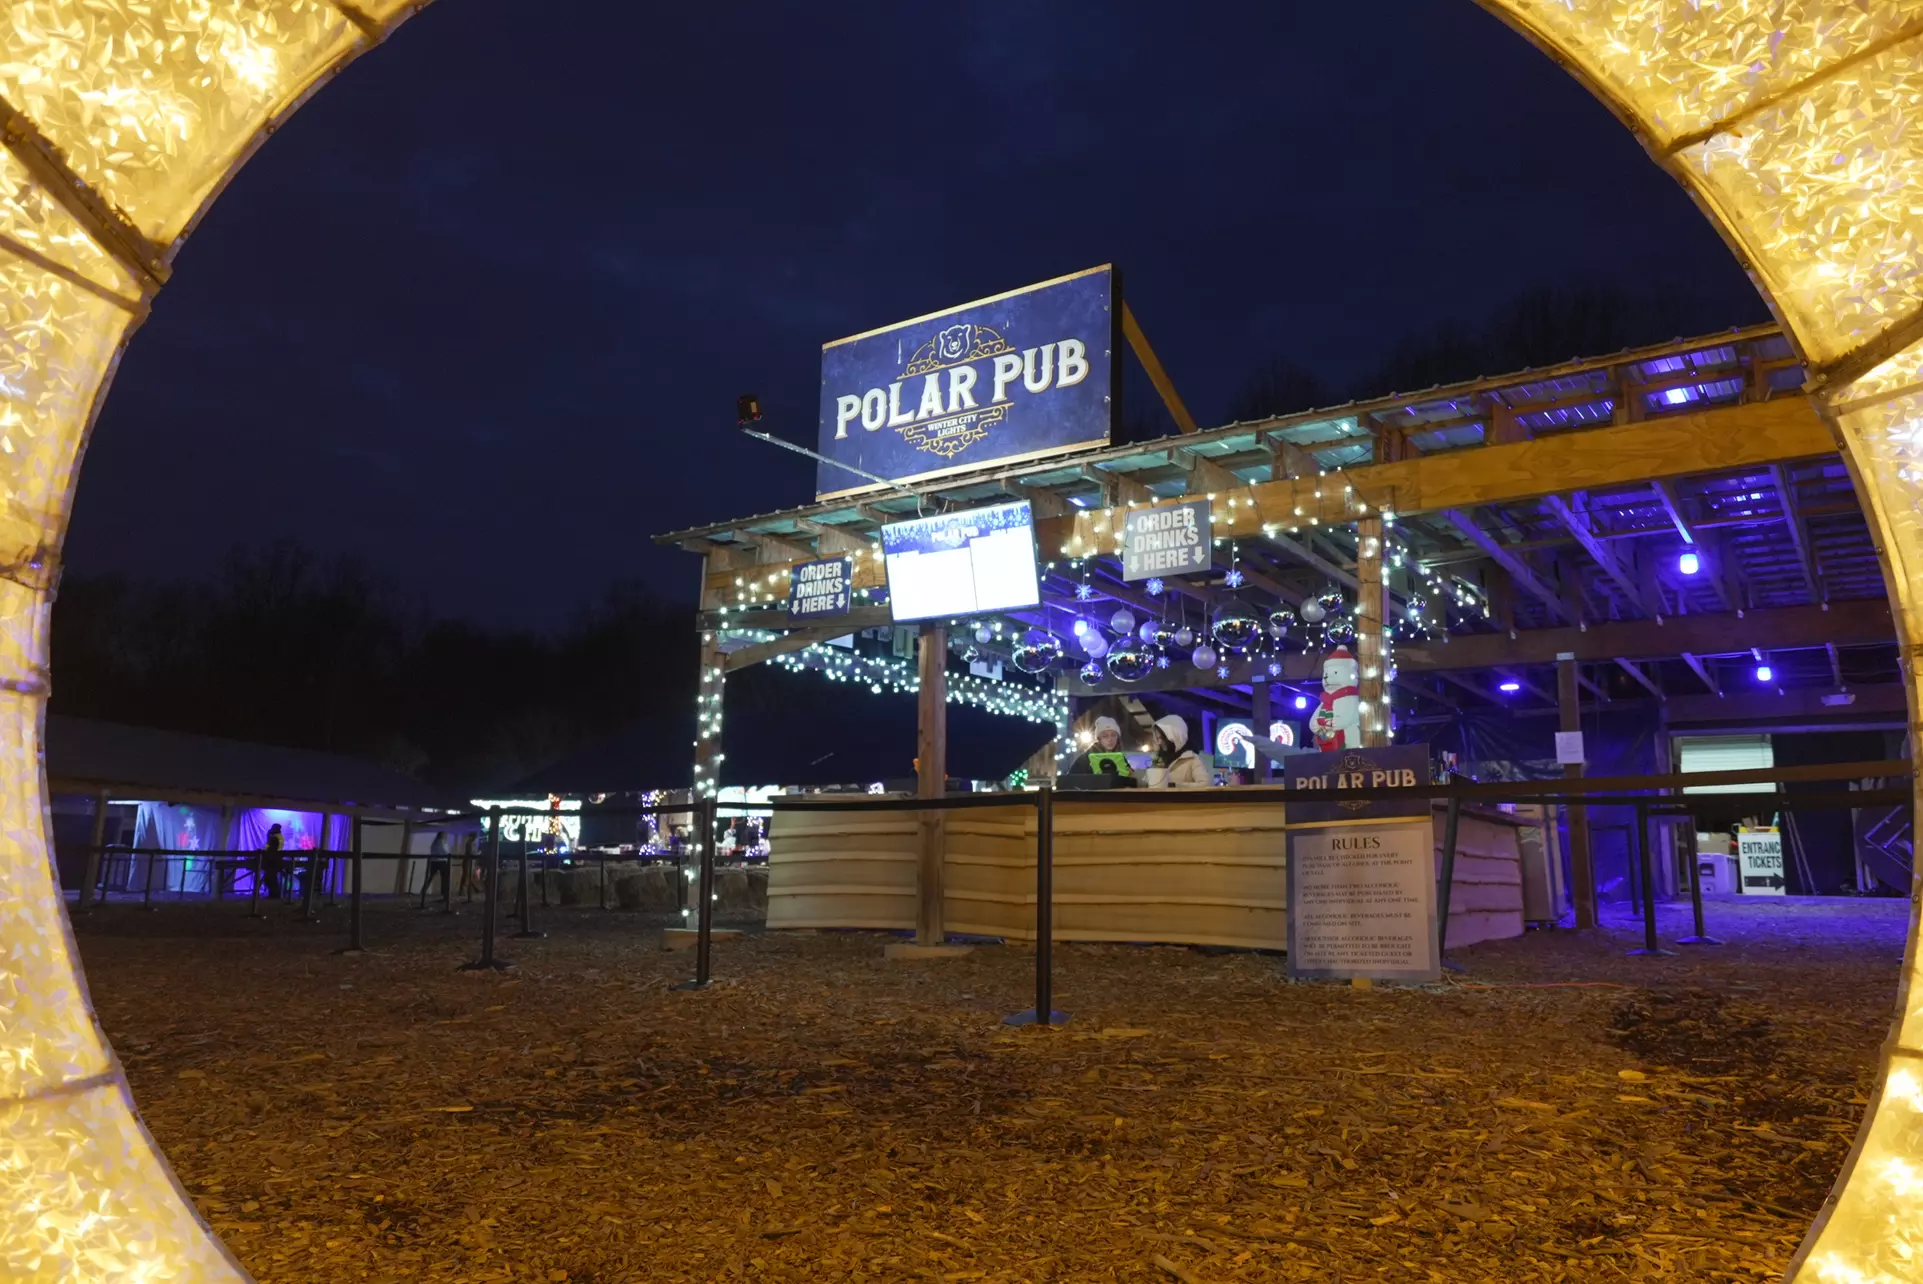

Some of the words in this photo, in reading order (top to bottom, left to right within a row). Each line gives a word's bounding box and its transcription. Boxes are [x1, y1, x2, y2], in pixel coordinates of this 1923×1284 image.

[835, 365, 979, 440] POLAR
[991, 338, 1089, 403] PUB
[928, 418, 959, 431] WINTER
[959, 413, 978, 425] CITY
[937, 424, 967, 437] LIGHTS
[1137, 508, 1196, 533] ORDER
[1134, 527, 1199, 553] DRINKS
[1144, 548, 1189, 571] HERE
[800, 562, 842, 582] ORDER
[796, 578, 844, 598] DRINKS
[801, 595, 835, 613] HERE
[1296, 772, 1364, 790] POLAR
[1372, 768, 1417, 787] PUB
[1332, 836, 1381, 850] RULES
[1742, 841, 1781, 854] ENTRANC
[1748, 856, 1782, 868] TICKETS
